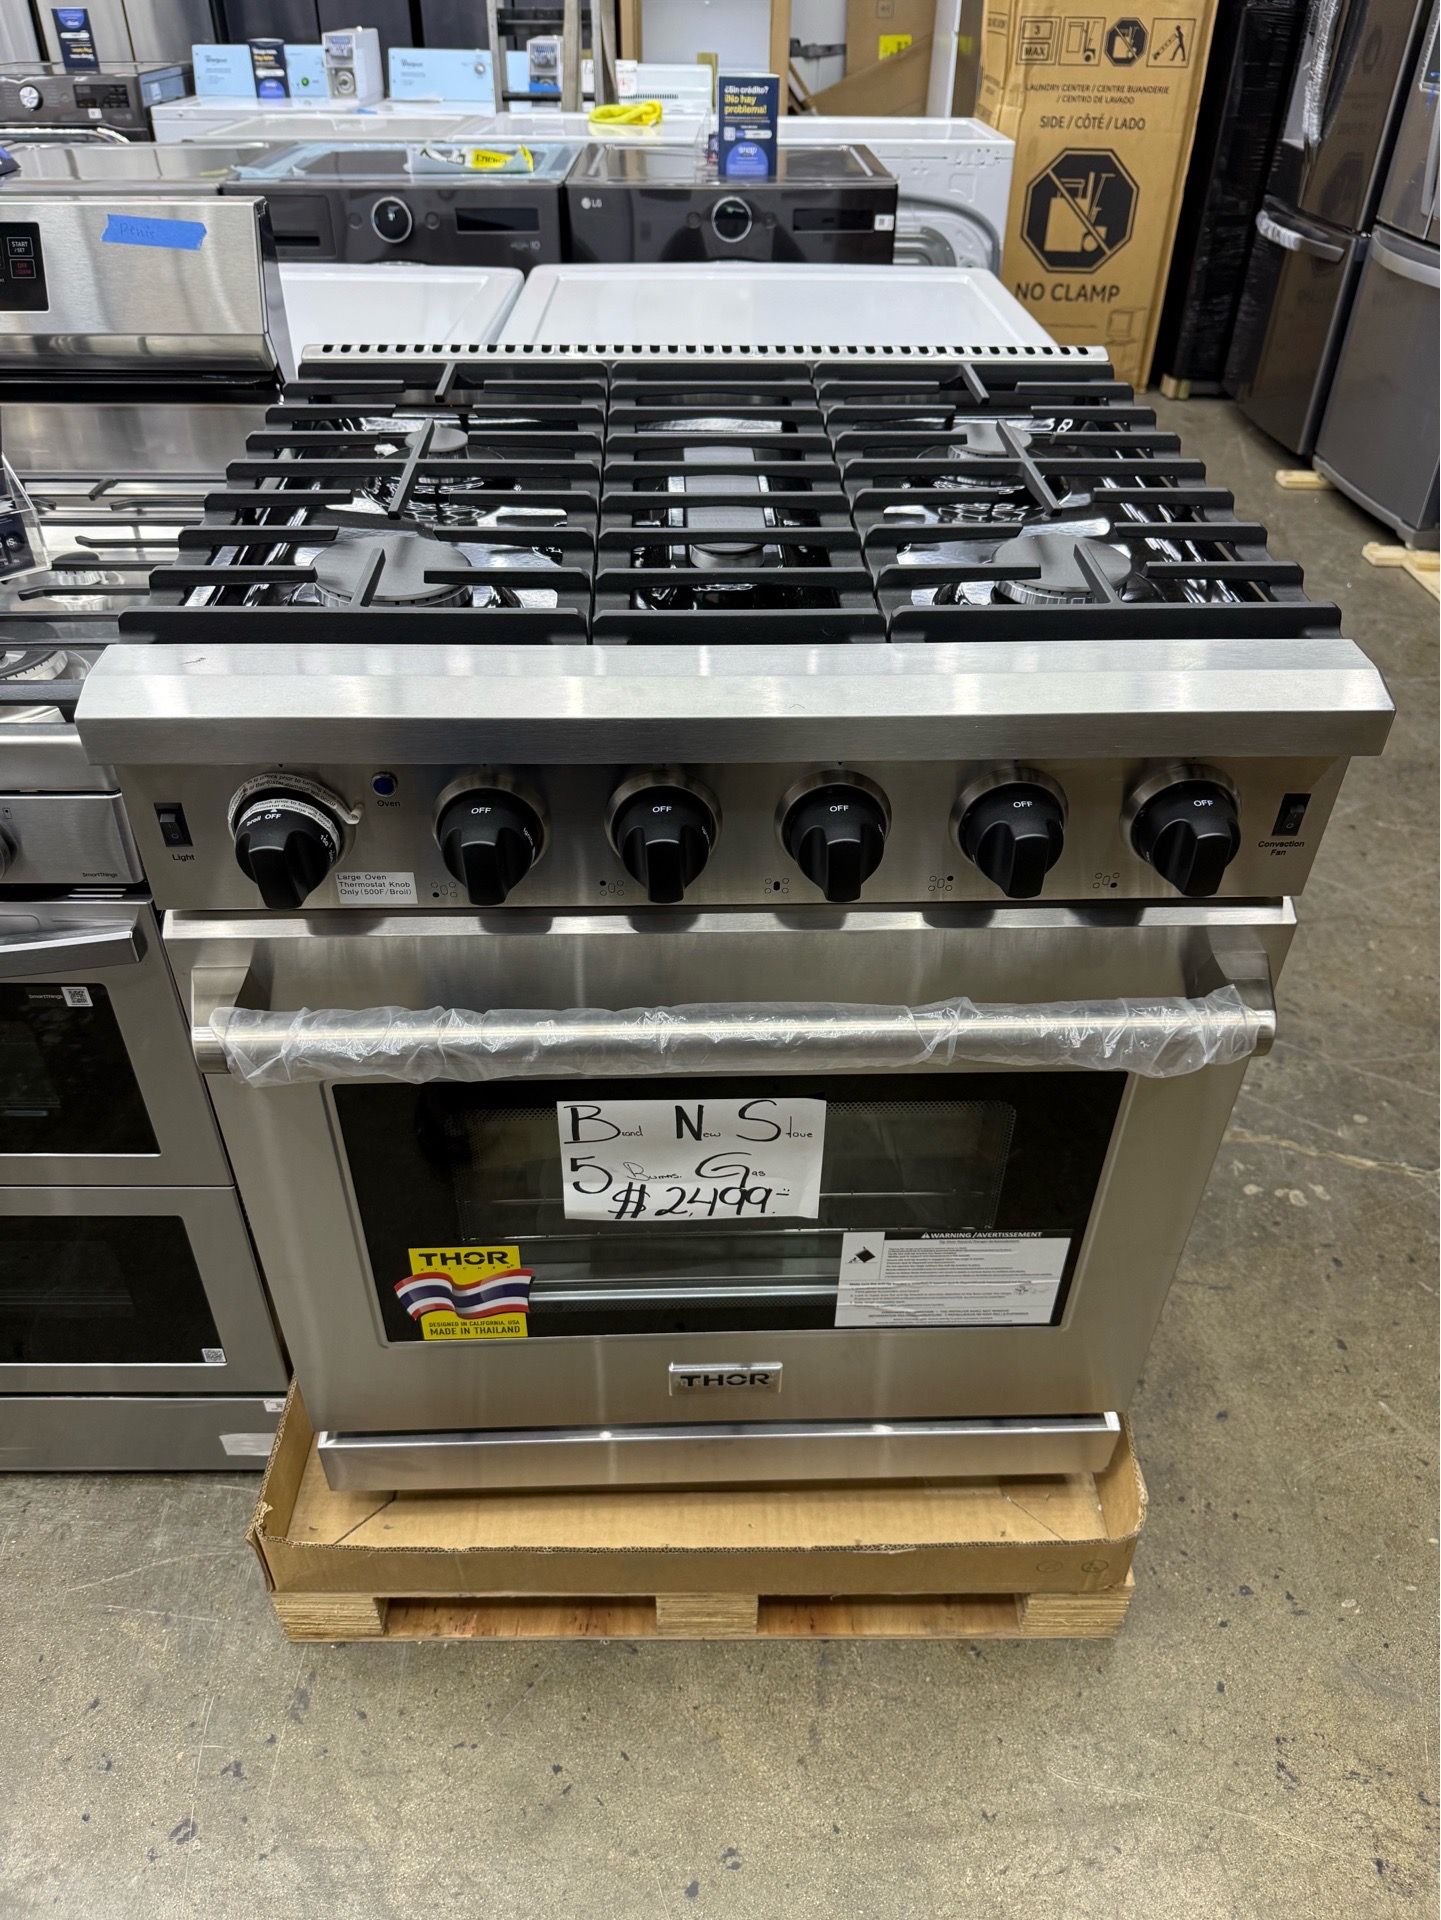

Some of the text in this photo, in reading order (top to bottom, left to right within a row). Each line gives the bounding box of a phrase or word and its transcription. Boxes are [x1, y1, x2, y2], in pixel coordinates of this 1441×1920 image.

[1033, 25, 1041, 35] 3
[1024, 47, 1045, 57] MAX
[1096, 85, 1125, 93] CENTRE
[1040, 115, 1065, 129] SIDE
[1075, 114, 1105, 130] CÔTÉ
[1114, 117, 1146, 131] LADO
[1016, 282, 1121, 303] NO CLAMP
[376, 799, 401, 807] Oven
[471, 806, 492, 814] OFF
[652, 805, 673, 813] OFF
[829, 805, 849, 813] OFF
[1257, 840, 1305, 848] Convection
[1269, 848, 1287, 856] Fan
[172, 853, 196, 862] Light
[674, 1103, 721, 1141] New
[736, 1099, 814, 1142] Stove
[570, 1156, 613, 1194] 5
[694, 1151, 767, 1190] Gas
[418, 1251, 510, 1267] THOR
[429, 1320, 460, 1328] DESIGNED
[430, 1325, 521, 1336] MADE IN THAILAND
[680, 1373, 770, 1387] THOR
